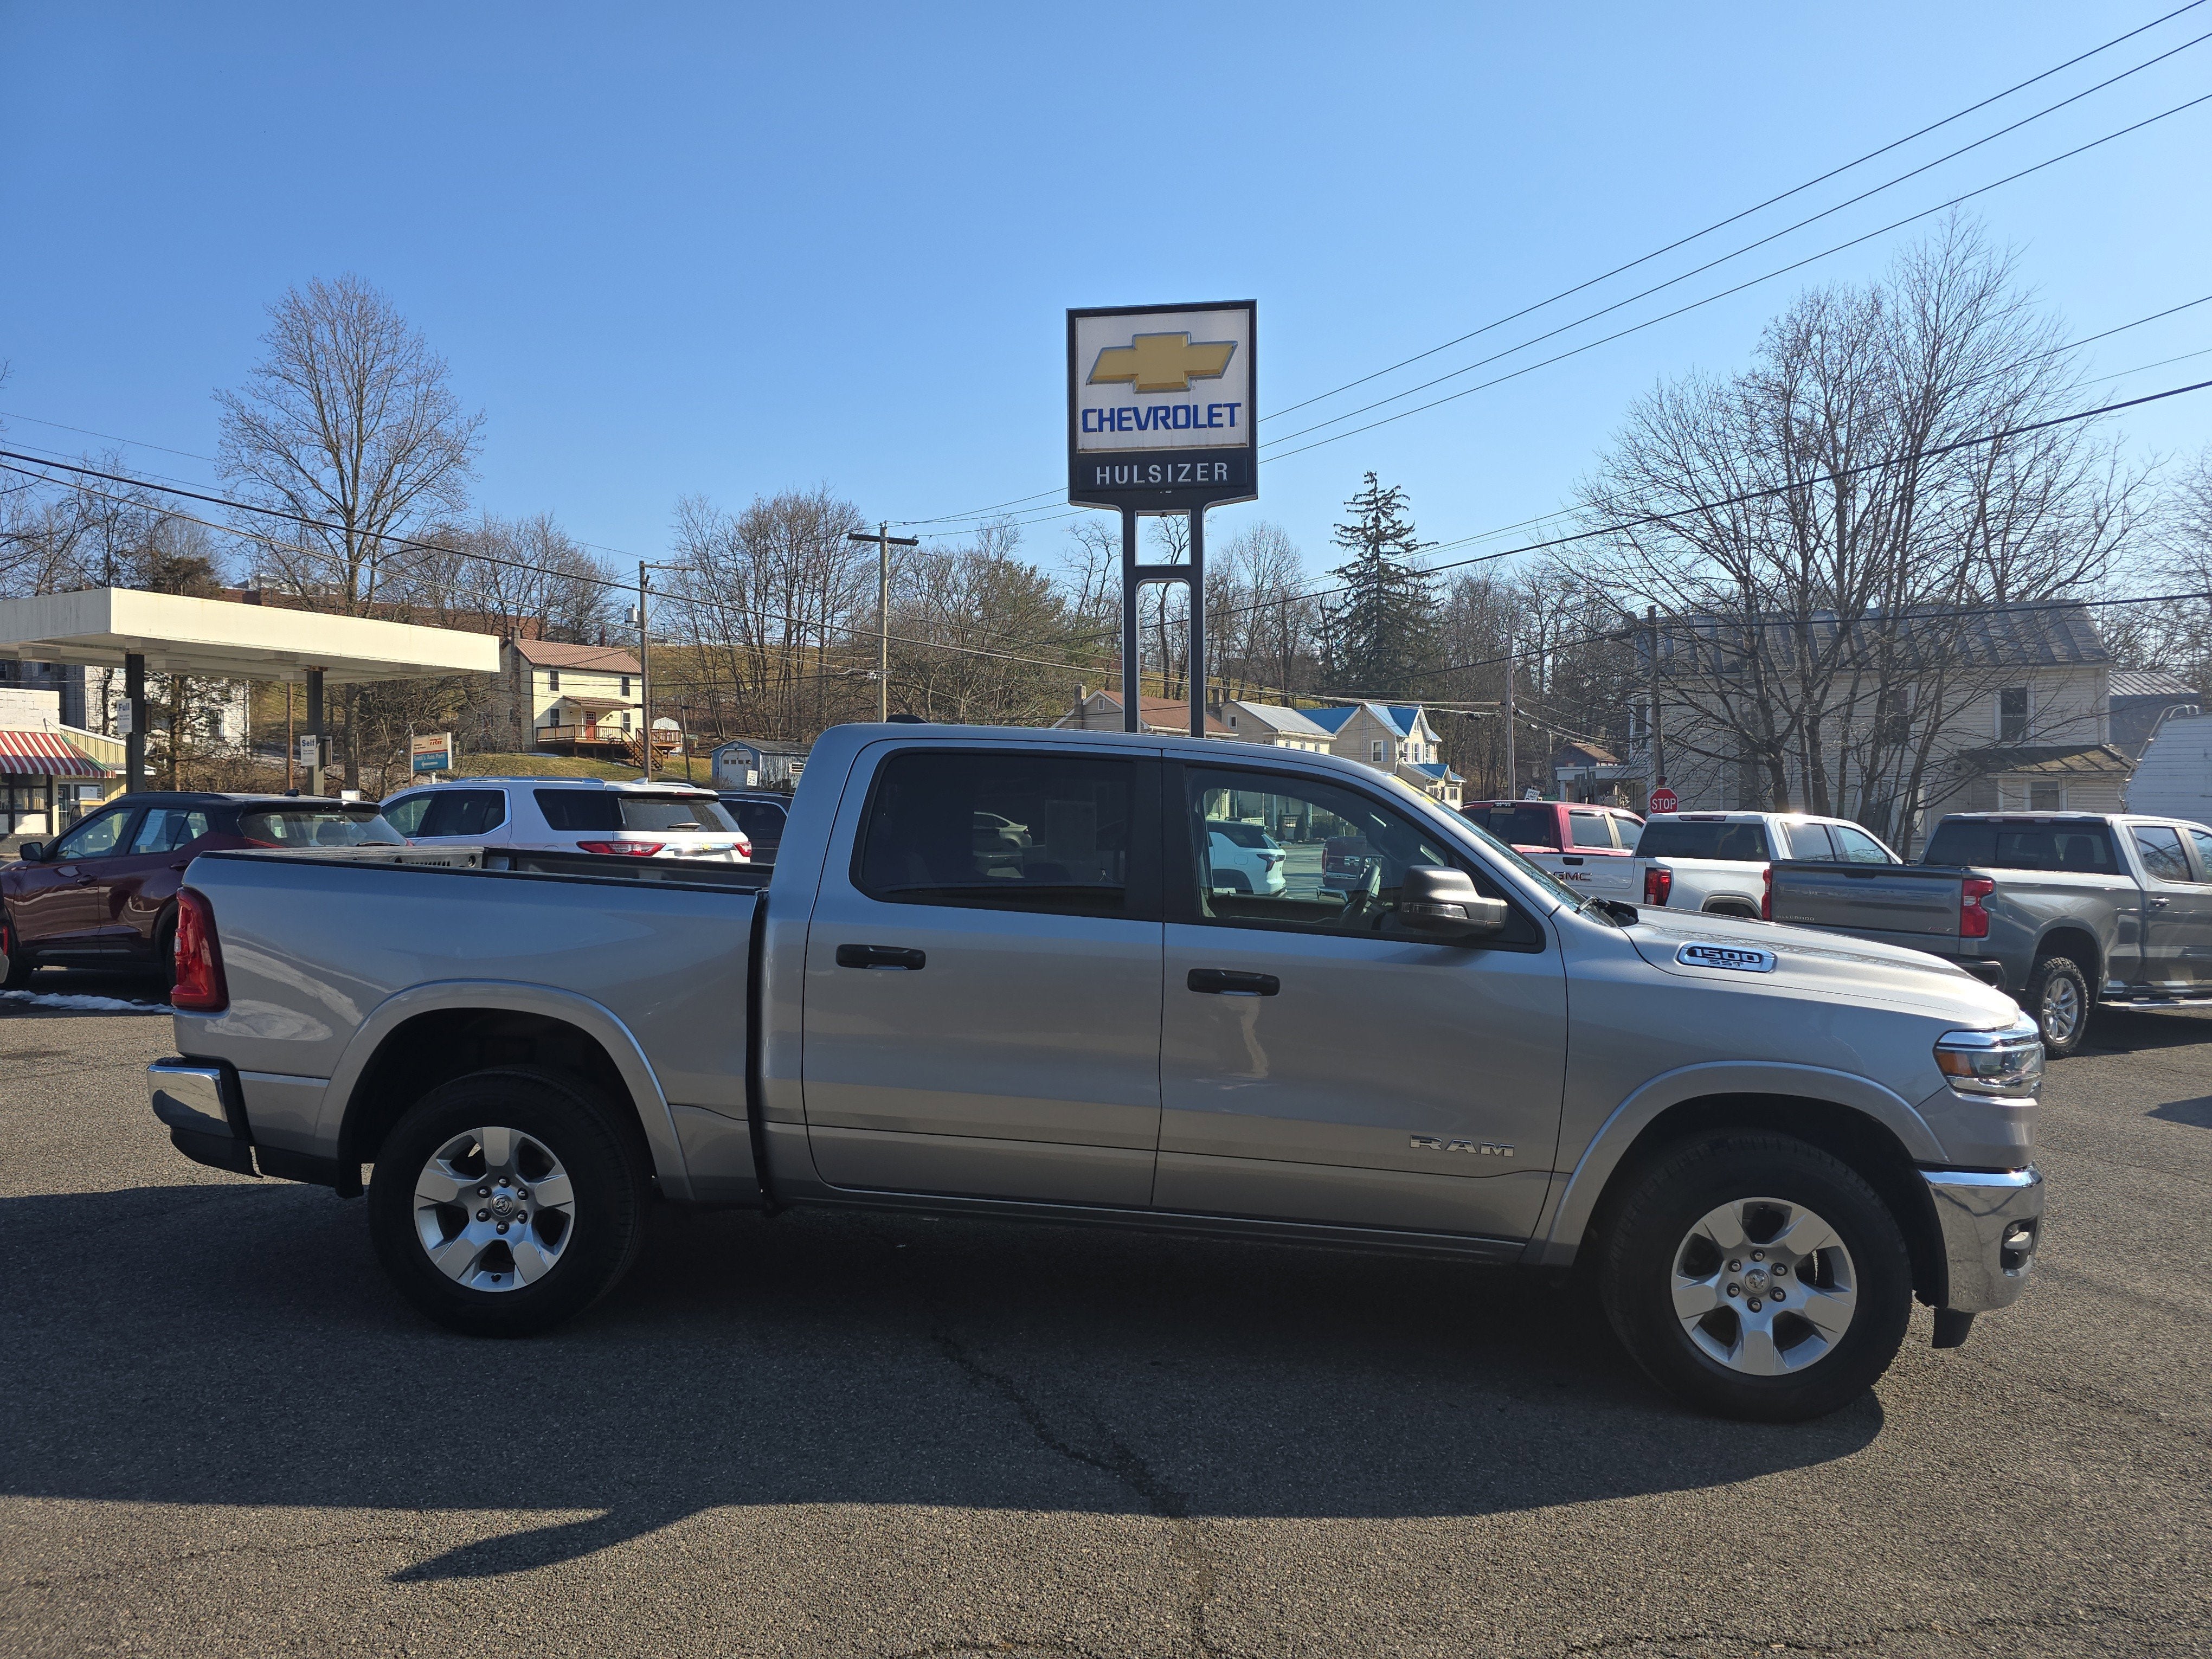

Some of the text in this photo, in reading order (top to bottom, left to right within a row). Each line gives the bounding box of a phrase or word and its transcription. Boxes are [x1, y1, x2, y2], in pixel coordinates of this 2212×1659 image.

[1082, 402, 1242, 433] CHEVROLET
[1096, 462, 1228, 485] HULSIZER
[118, 702, 130, 712] Full
[301, 739, 315, 747] Self
[1651, 798, 1676, 810] STOP
[1553, 871, 1593, 882] GMC
[1693, 948, 1759, 962] 1500
[1410, 1135, 1515, 1158] RAM
